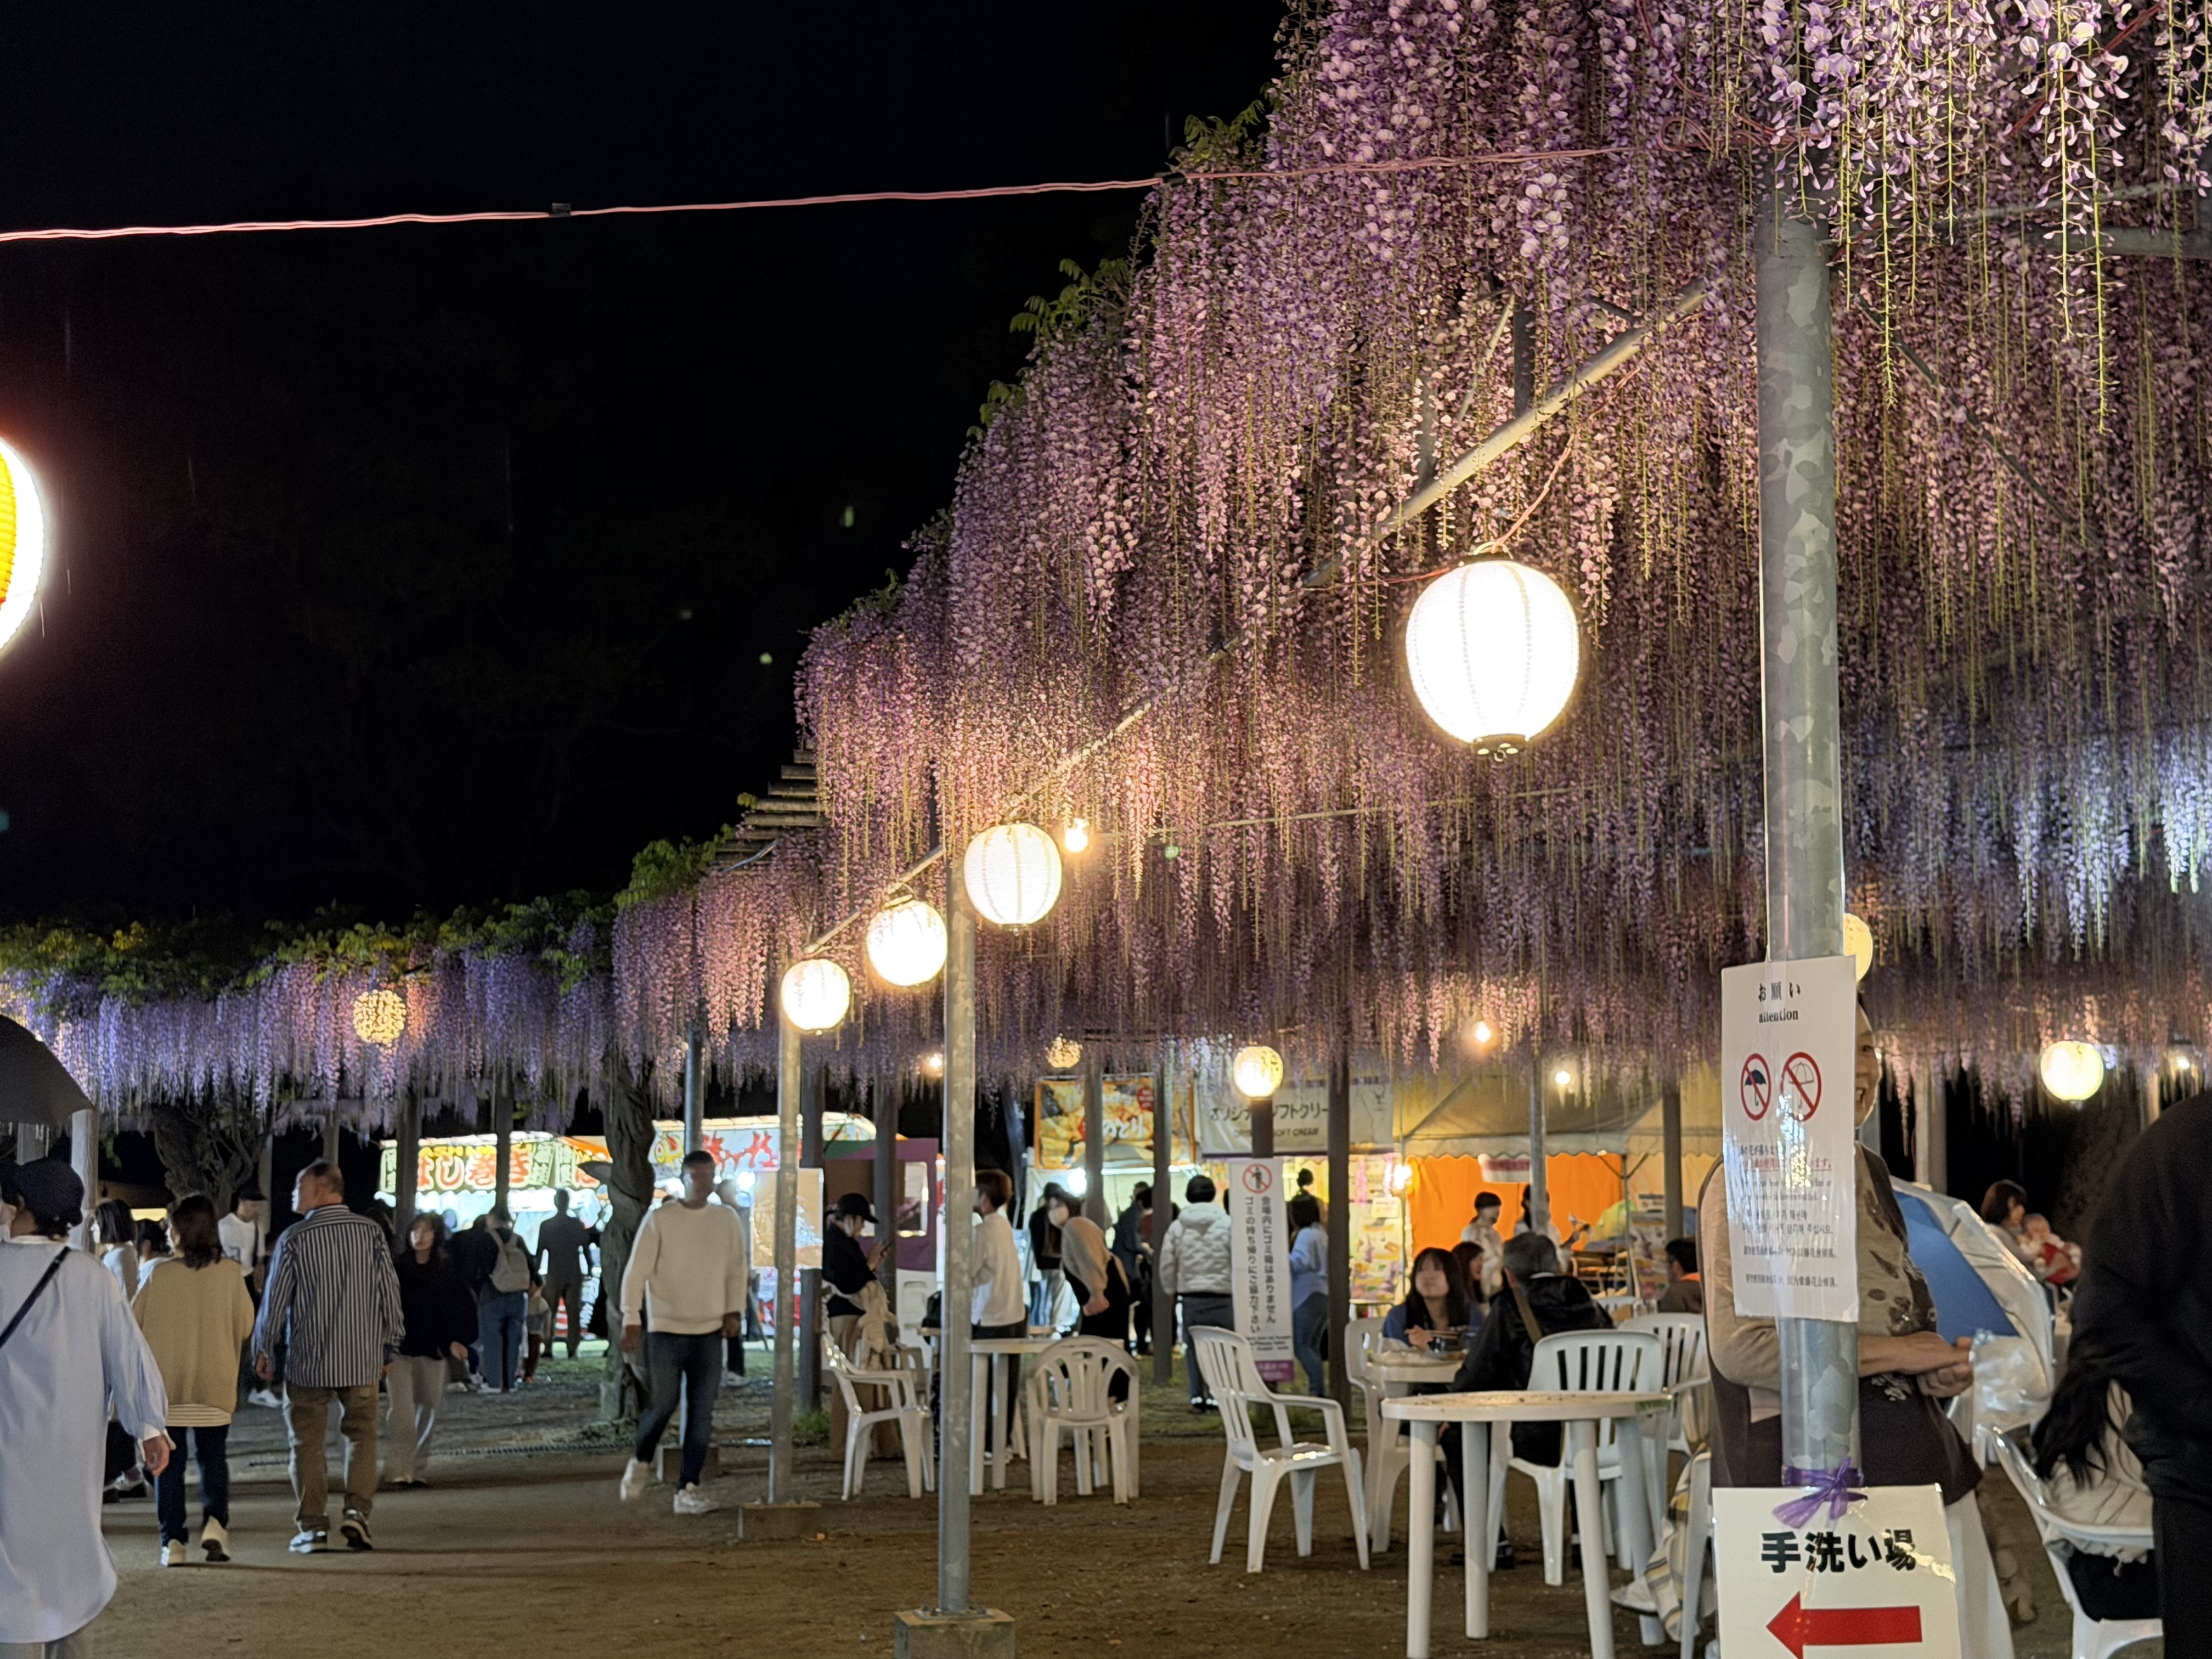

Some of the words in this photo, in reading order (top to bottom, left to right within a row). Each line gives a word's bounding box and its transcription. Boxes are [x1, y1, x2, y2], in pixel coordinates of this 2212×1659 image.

[1758, 981, 1801, 1002] お願い
[1759, 1008, 1799, 1023] attention
[1761, 1529, 1916, 1573] 手洗い場
